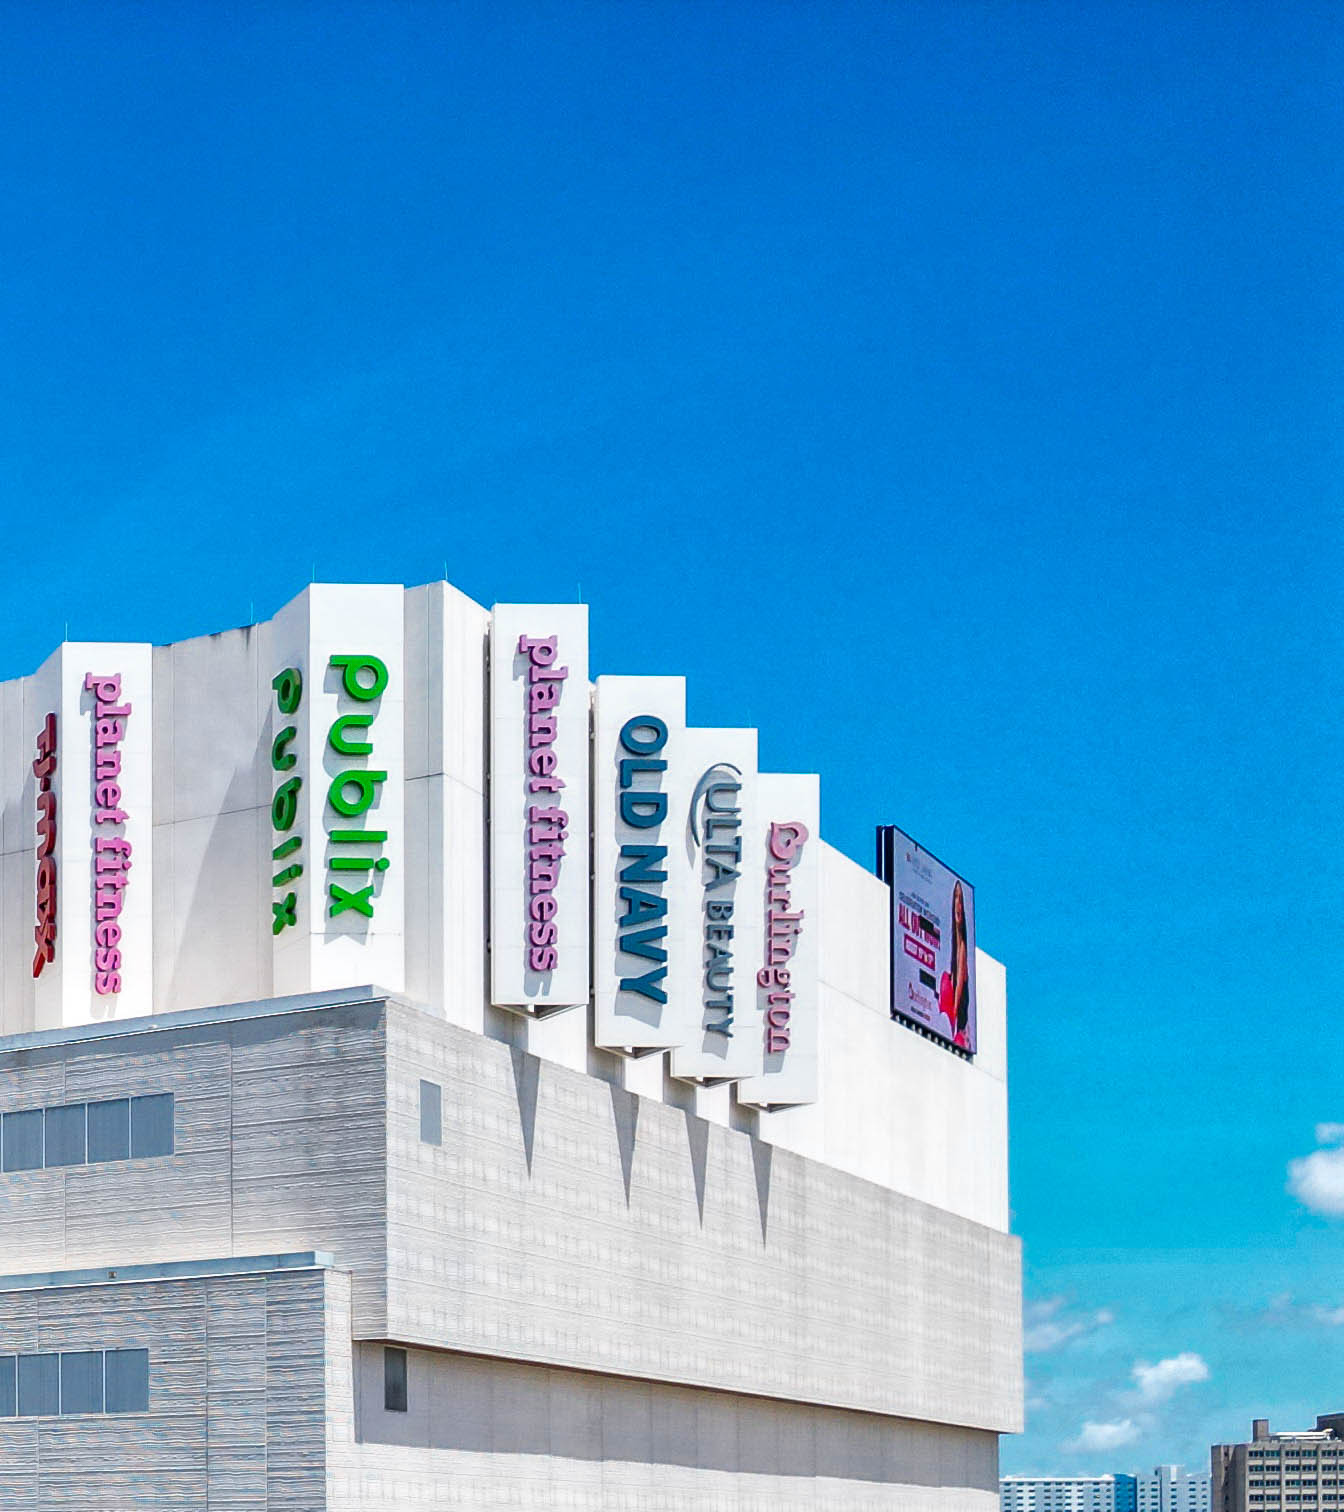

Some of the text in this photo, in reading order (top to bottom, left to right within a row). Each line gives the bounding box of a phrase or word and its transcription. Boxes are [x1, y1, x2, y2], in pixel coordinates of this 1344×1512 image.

[85, 671, 132, 996] planet fitness
[329, 654, 390, 919] Publix
[518, 634, 569, 972] planet fitness
[619, 714, 668, 1005] OLD NAVY
[705, 783, 742, 1038] ULTA BEAUTY
[757, 821, 809, 1053] Burlington
